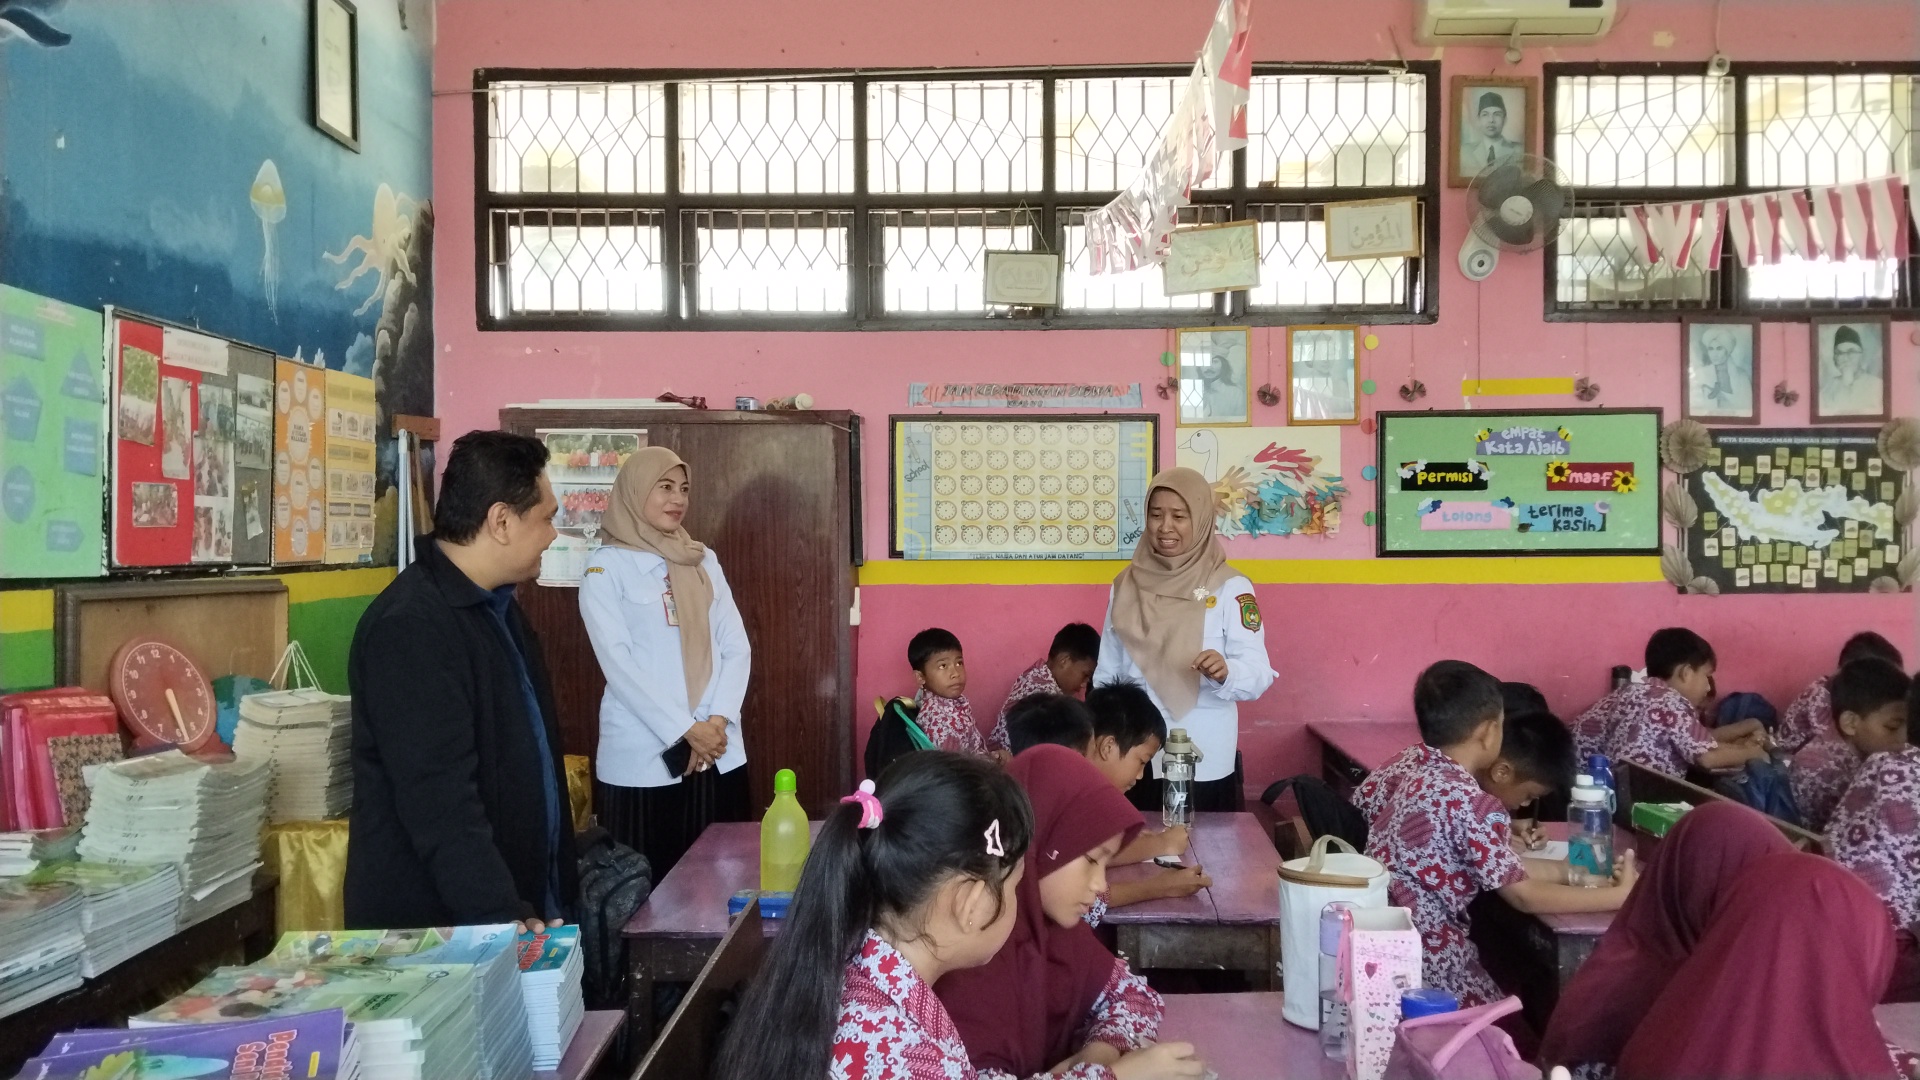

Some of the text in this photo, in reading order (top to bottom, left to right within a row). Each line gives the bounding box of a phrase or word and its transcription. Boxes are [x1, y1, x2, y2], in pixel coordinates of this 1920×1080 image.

[904, 458, 930, 483] school
[1568, 471, 1613, 486] maaf
[1441, 511, 1493, 523] tolong
[1122, 526, 1144, 545] class
[150, 649, 161, 659] 12
[169, 654, 176, 664] 1
[136, 655, 146, 665] 11
[129, 669, 139, 680] 10
[185, 667, 192, 677] 2
[130, 689, 137, 699] 9
[195, 687, 203, 697] 3
[141, 709, 148, 720] 8
[197, 707, 203, 716] 4
[157, 723, 163, 733] 7
[189, 721, 196, 731] 5
[175, 728, 182, 738] 6
